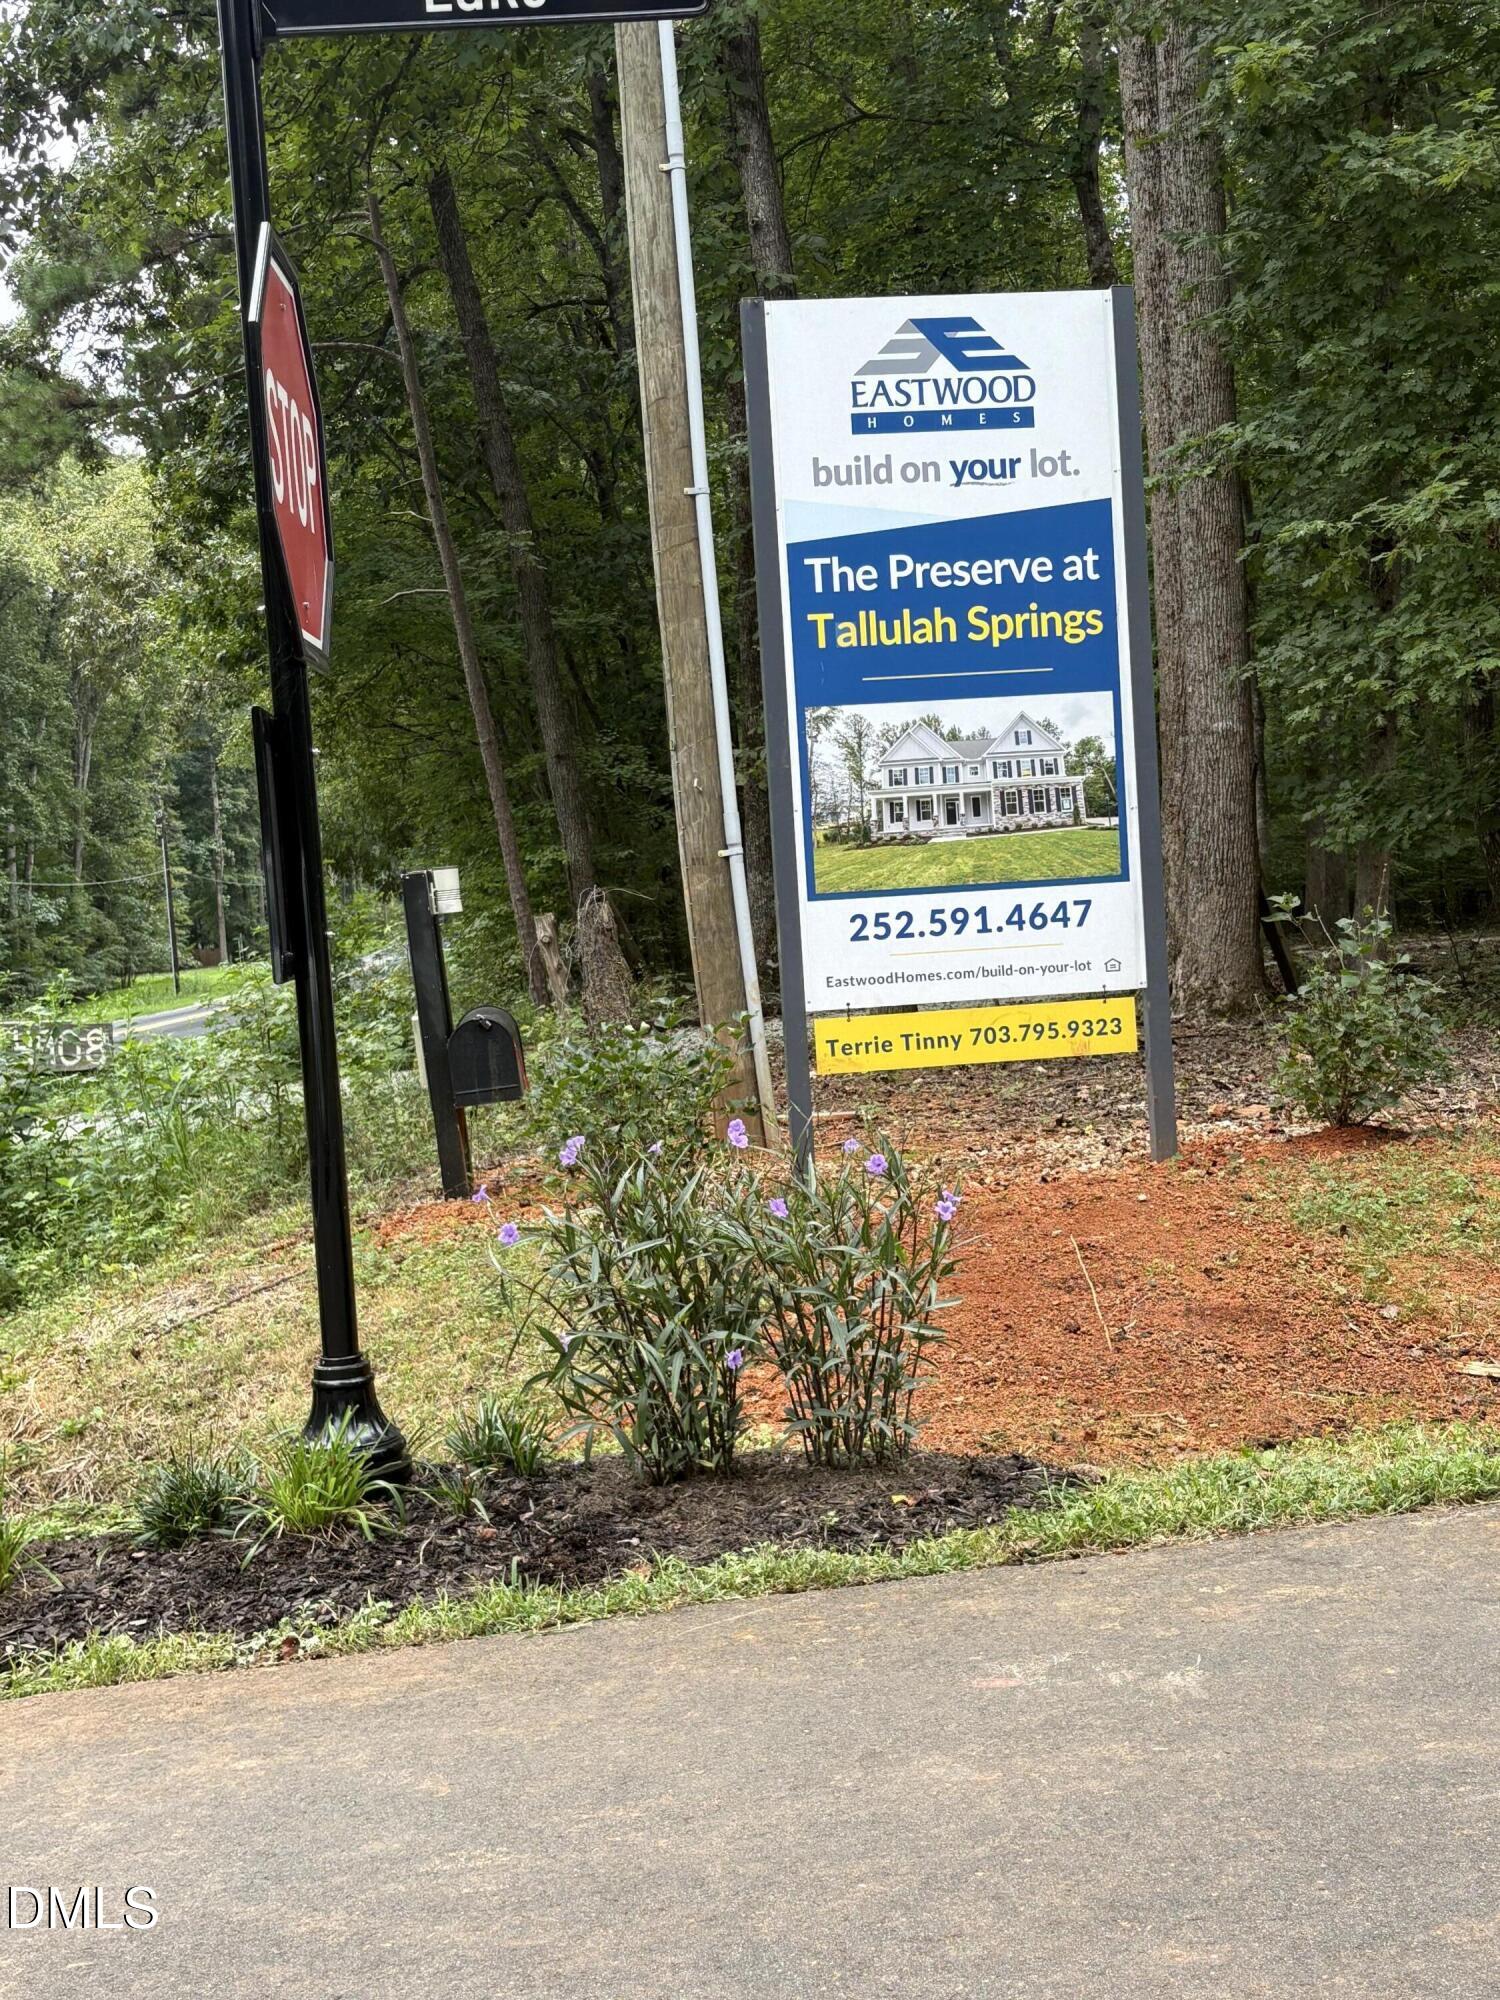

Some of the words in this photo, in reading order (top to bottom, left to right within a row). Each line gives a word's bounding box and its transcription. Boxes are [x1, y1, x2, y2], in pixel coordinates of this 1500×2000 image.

[850, 374, 1036, 408] EASTWOOD
[867, 411, 1021, 429] HOMES
[266, 368, 316, 534] STOP
[811, 454, 893, 487] build
[900, 460, 941, 484] on
[949, 457, 1022, 487] your
[1030, 447, 1080, 478] lot.
[803, 556, 878, 593] The
[889, 554, 1053, 590] Preserve
[1063, 547, 1100, 581] at
[807, 607, 957, 649] Tallulah
[967, 602, 1104, 648] Springs
[849, 899, 1092, 942] 252.591.4647
[825, 959, 1092, 989] EastwoodHomes.com/build-on-your-lot
[825, 1037, 893, 1058] Terrie
[900, 1031, 963, 1056] Tinny
[970, 1017, 1122, 1047] 703.795.9323
